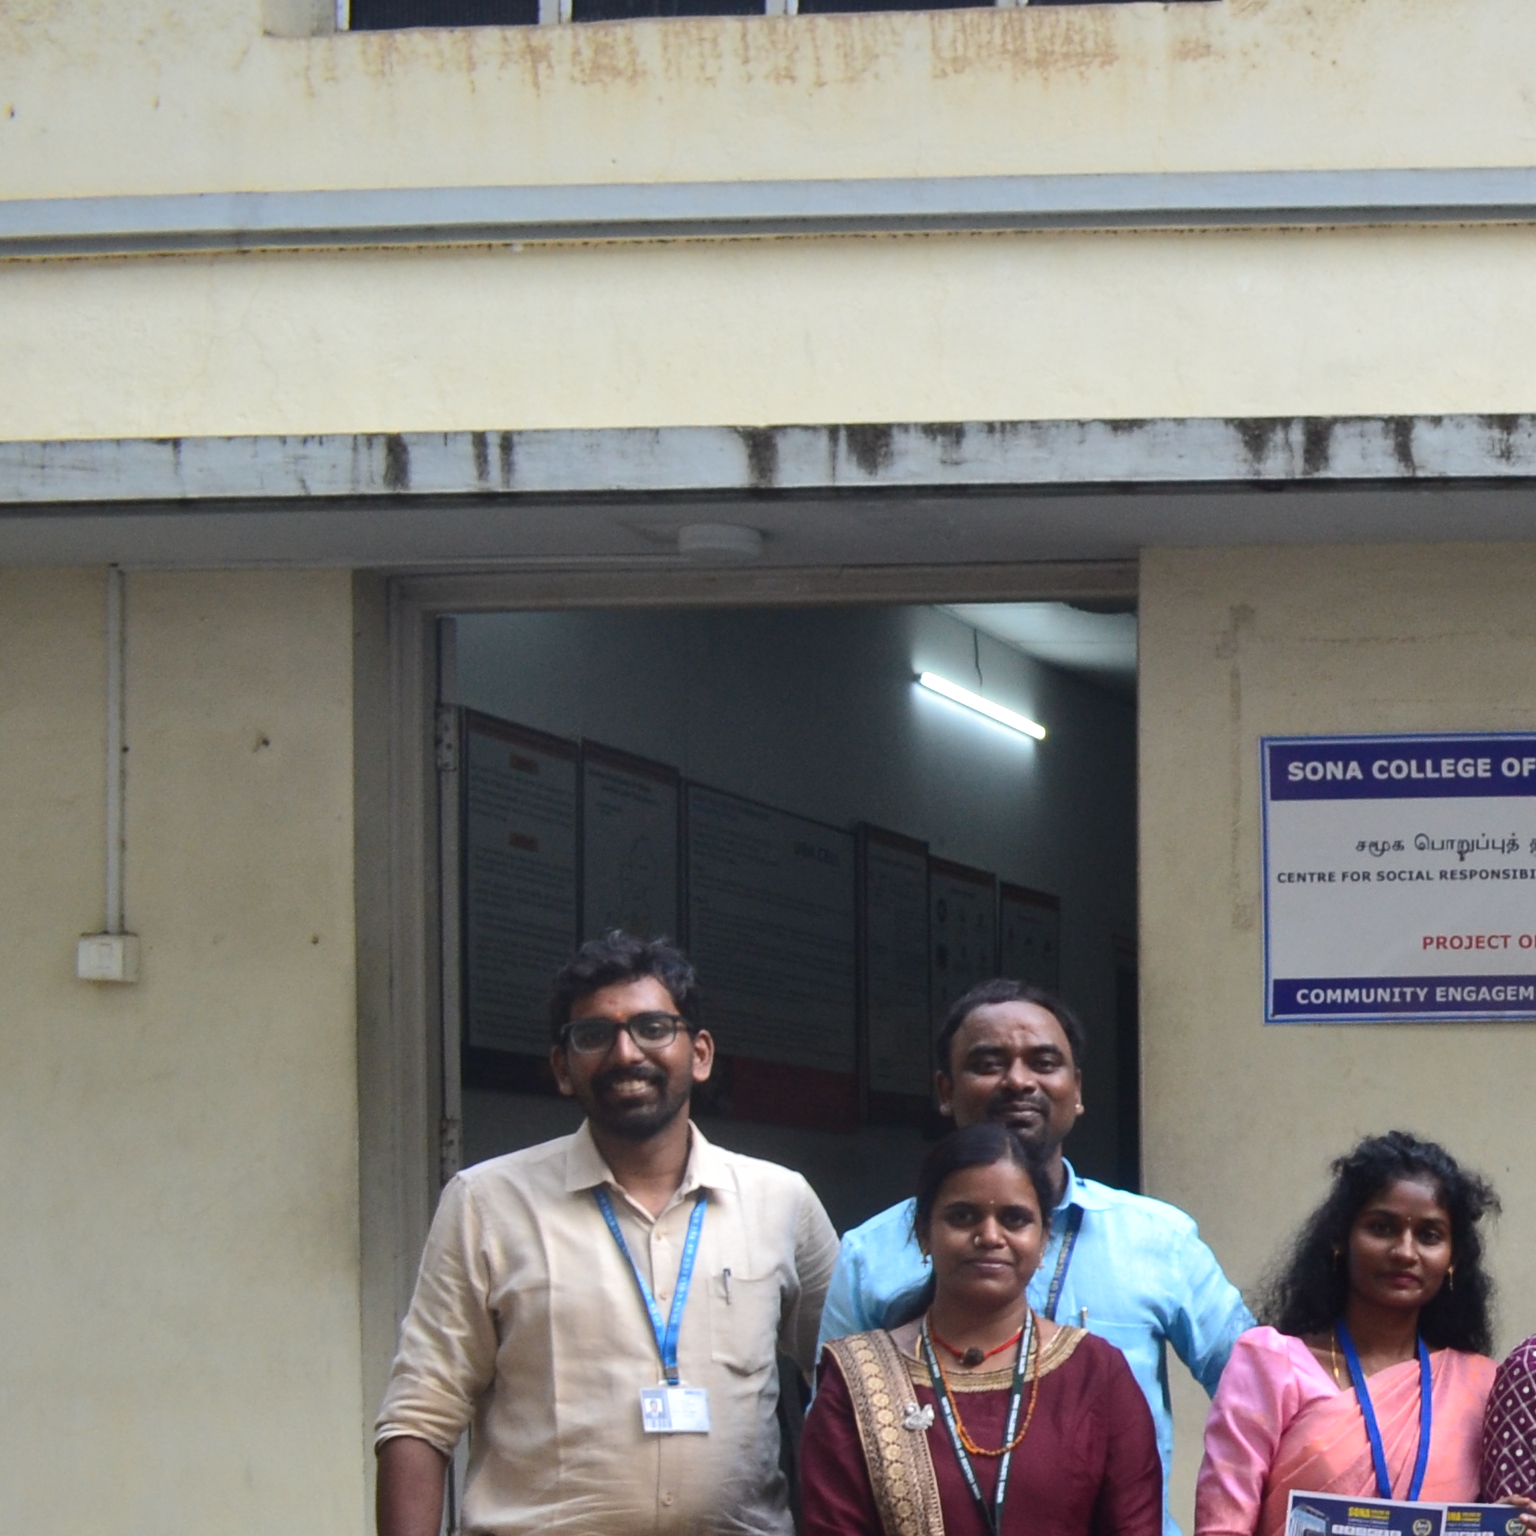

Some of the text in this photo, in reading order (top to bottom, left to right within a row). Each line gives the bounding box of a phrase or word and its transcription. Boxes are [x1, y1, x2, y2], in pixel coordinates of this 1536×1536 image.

[1287, 761, 1363, 781] SONA
[1372, 759, 1491, 780] COLLEGE
[1356, 837, 1405, 857] சமூக
[1414, 833, 1519, 861] பொறுப்புத்
[1277, 871, 1336, 883] CENTRE
[1342, 871, 1372, 882] FOR
[1377, 870, 1434, 882] SOCIAL
[1422, 935, 1512, 950] PROJECT
[1296, 987, 1429, 1005] COMMUNITY
